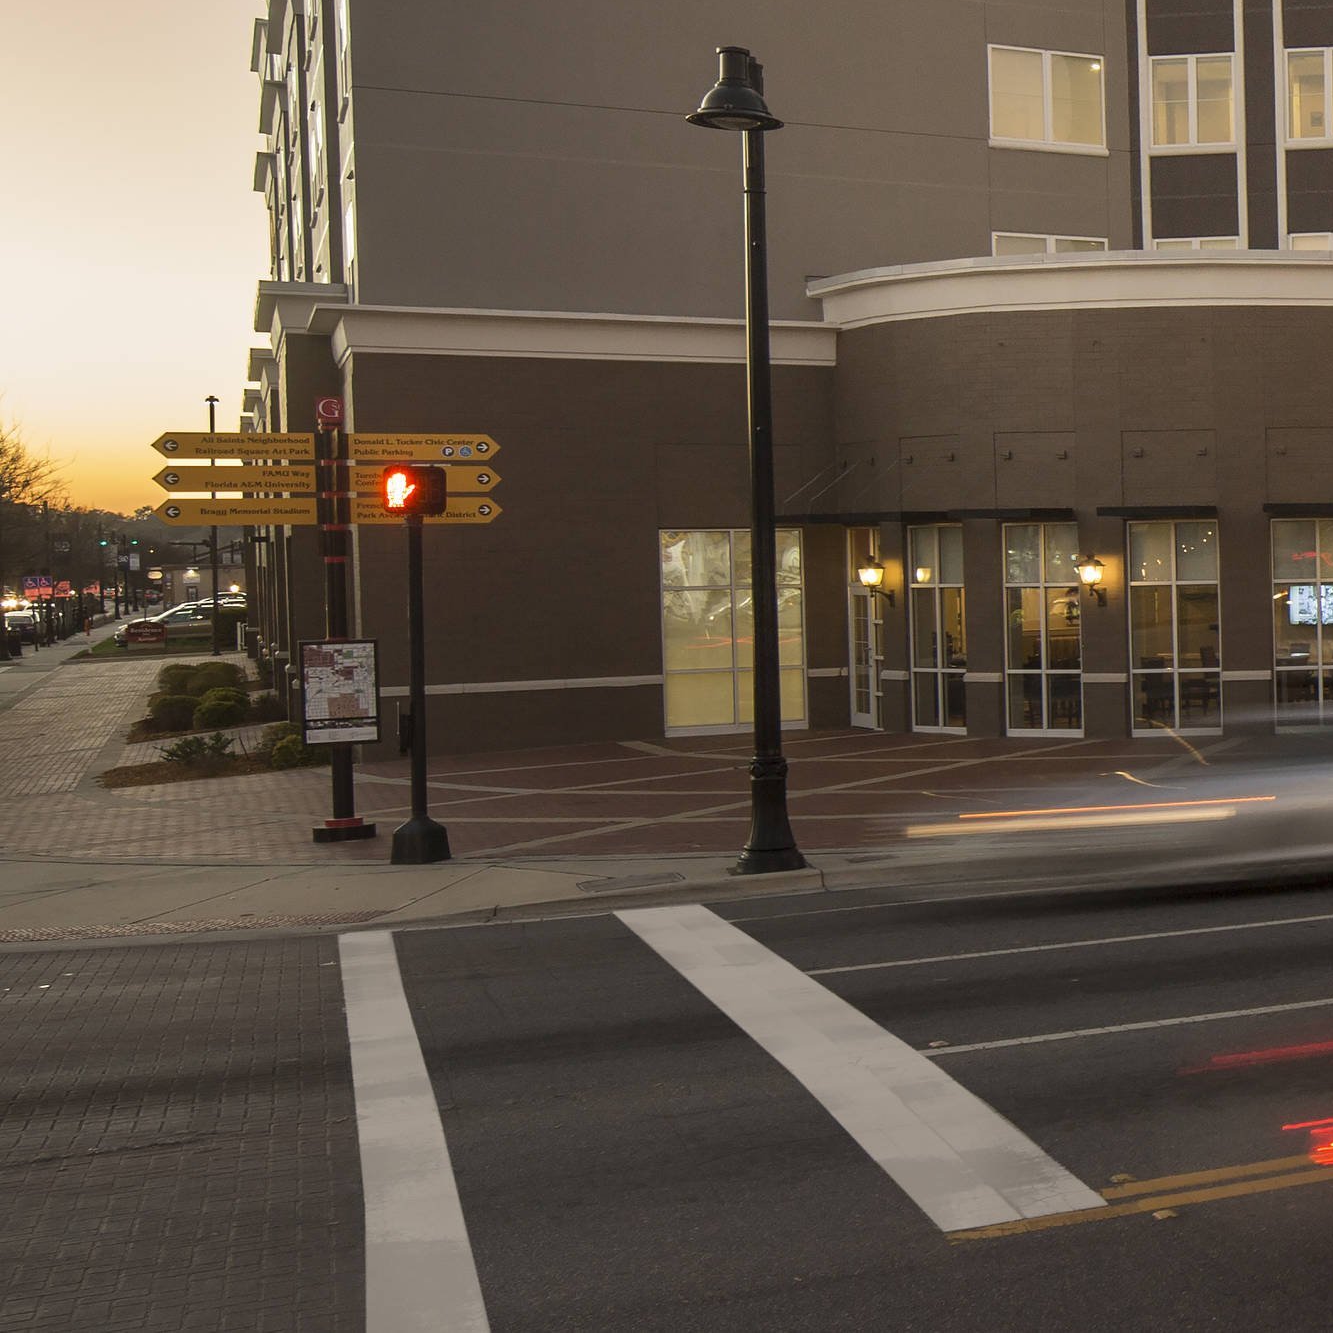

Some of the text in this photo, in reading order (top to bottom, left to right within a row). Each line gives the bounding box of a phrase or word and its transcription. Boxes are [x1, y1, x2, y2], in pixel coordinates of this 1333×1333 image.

[247, 437, 310, 446] Neighborhood
[237, 448, 270, 456] Square
[381, 449, 413, 457] Parking
[291, 470, 310, 478] Way
[265, 481, 311, 490] University
